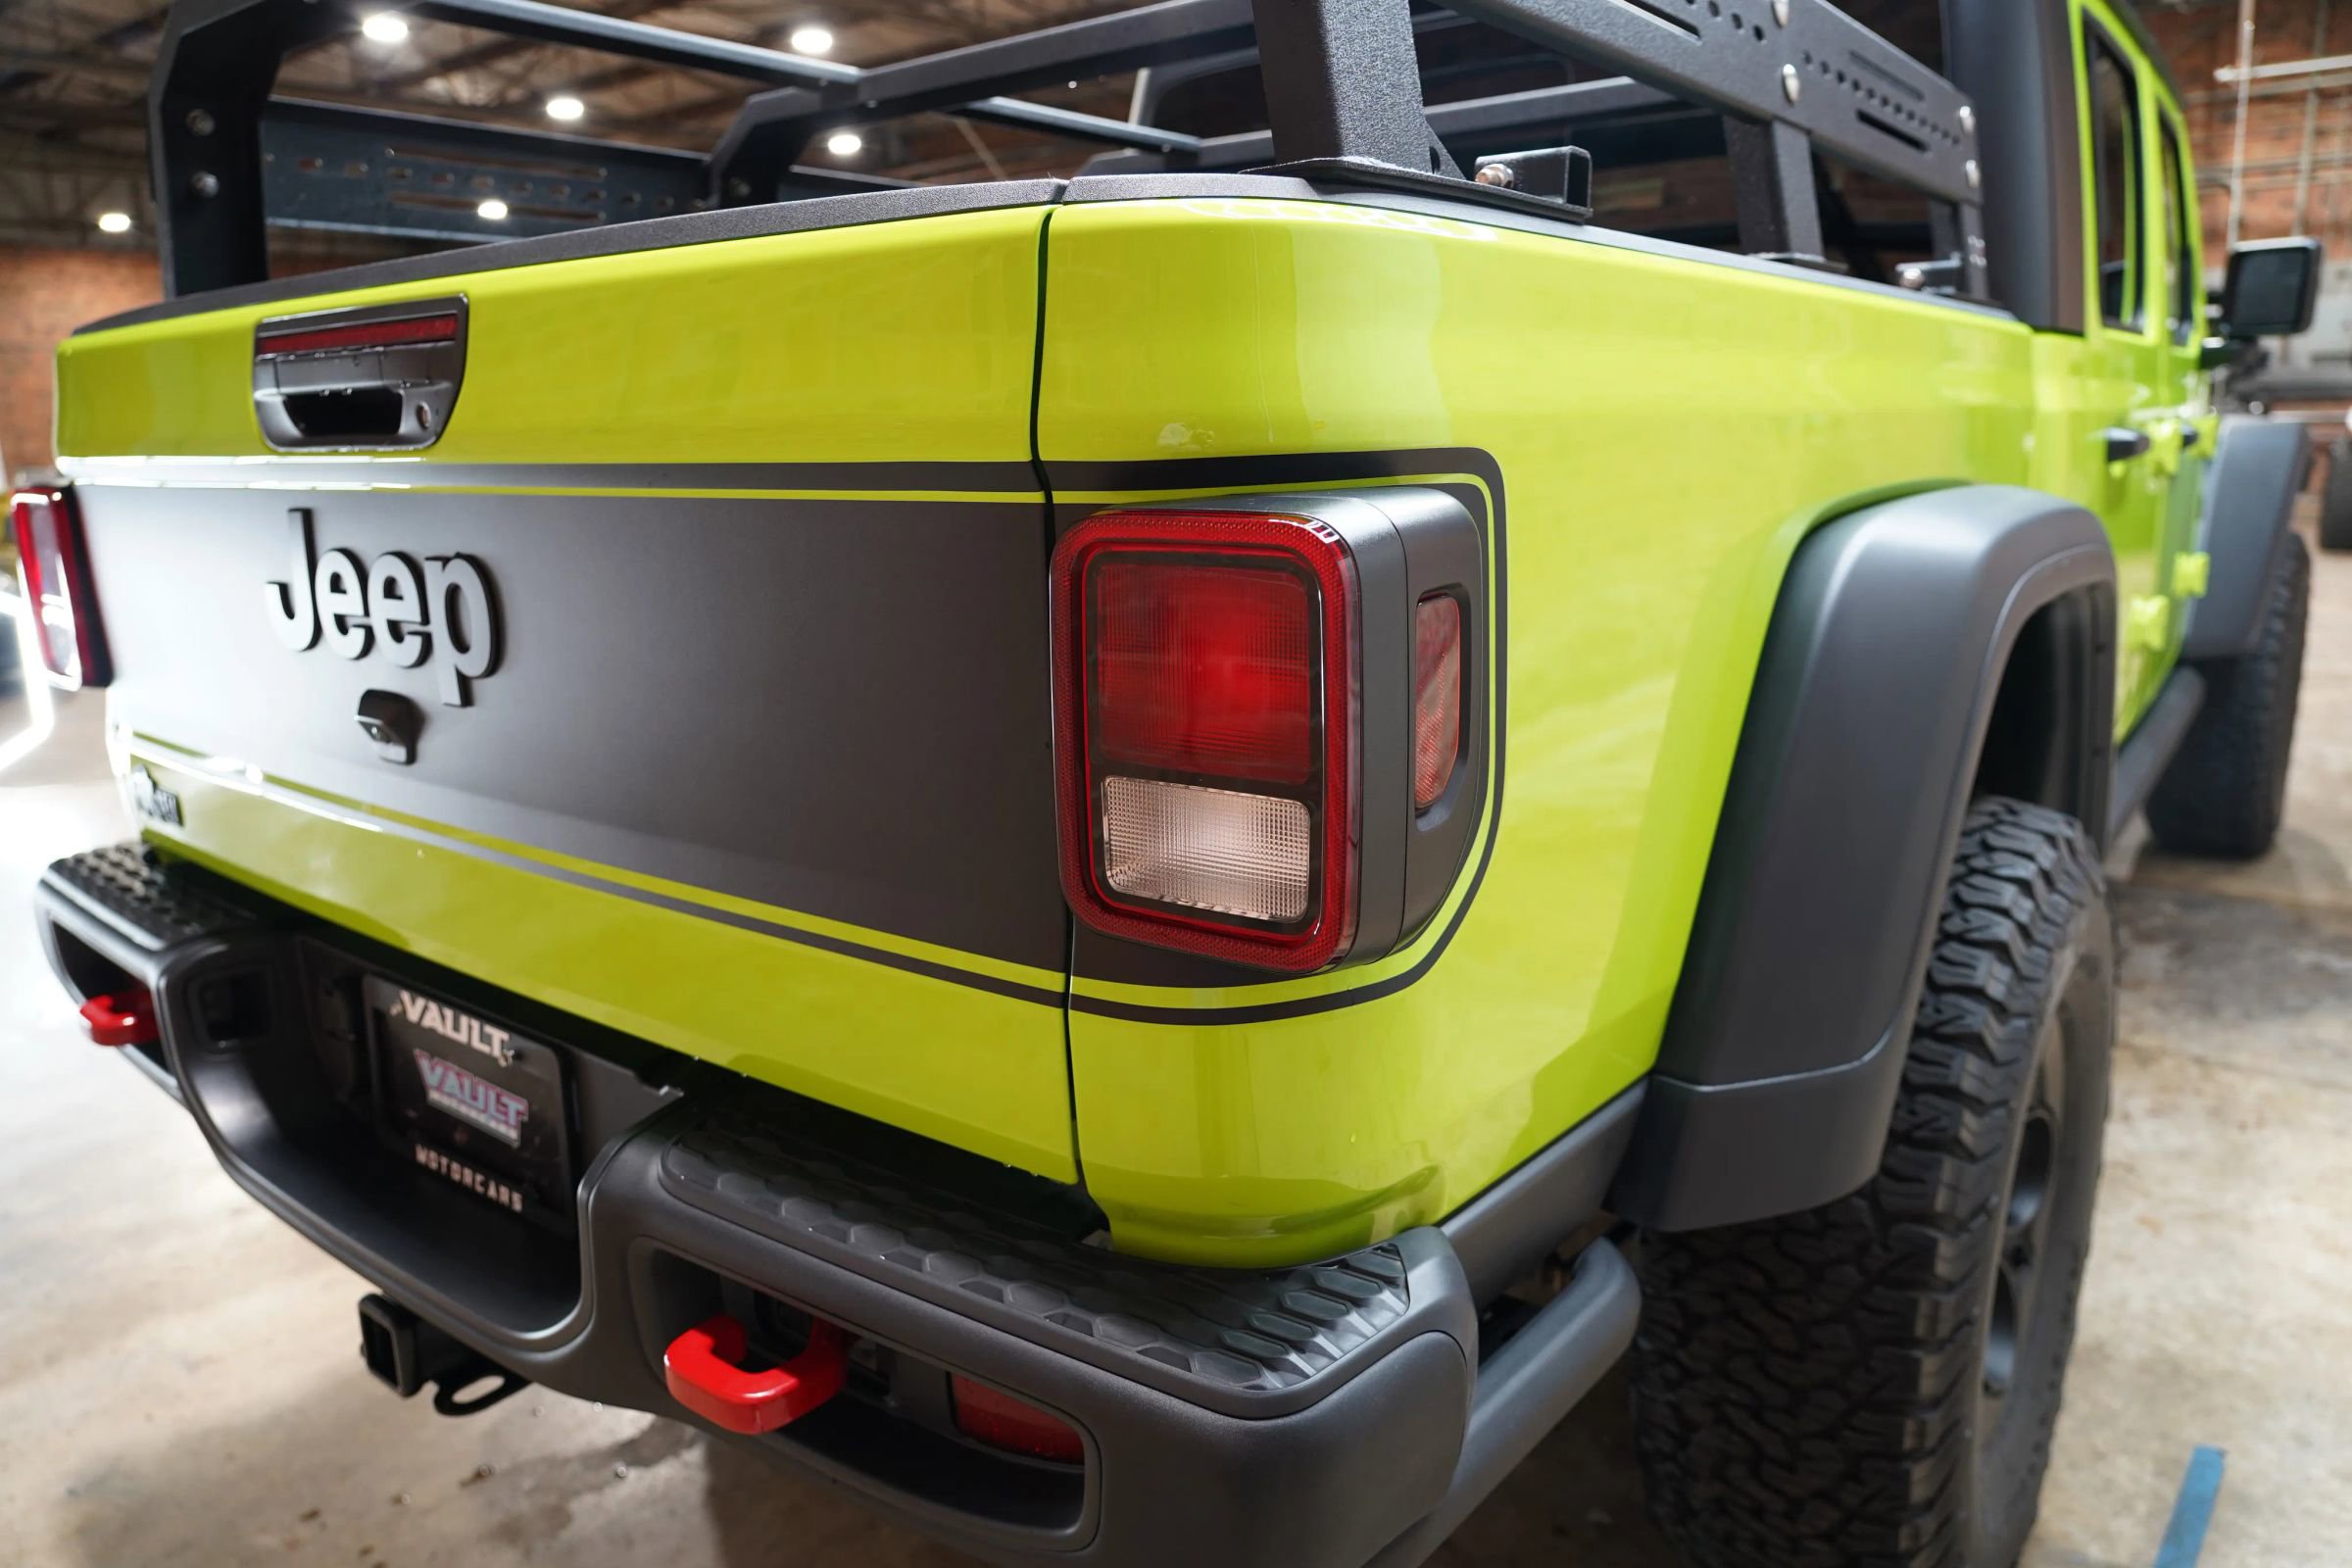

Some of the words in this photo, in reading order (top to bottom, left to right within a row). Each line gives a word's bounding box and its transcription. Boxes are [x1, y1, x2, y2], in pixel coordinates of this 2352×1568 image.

[263, 506, 507, 709] Jeep
[398, 989, 510, 1058] VAULT
[418, 1055, 525, 1125] VAULT
[415, 1143, 523, 1212] MOTORCARS
